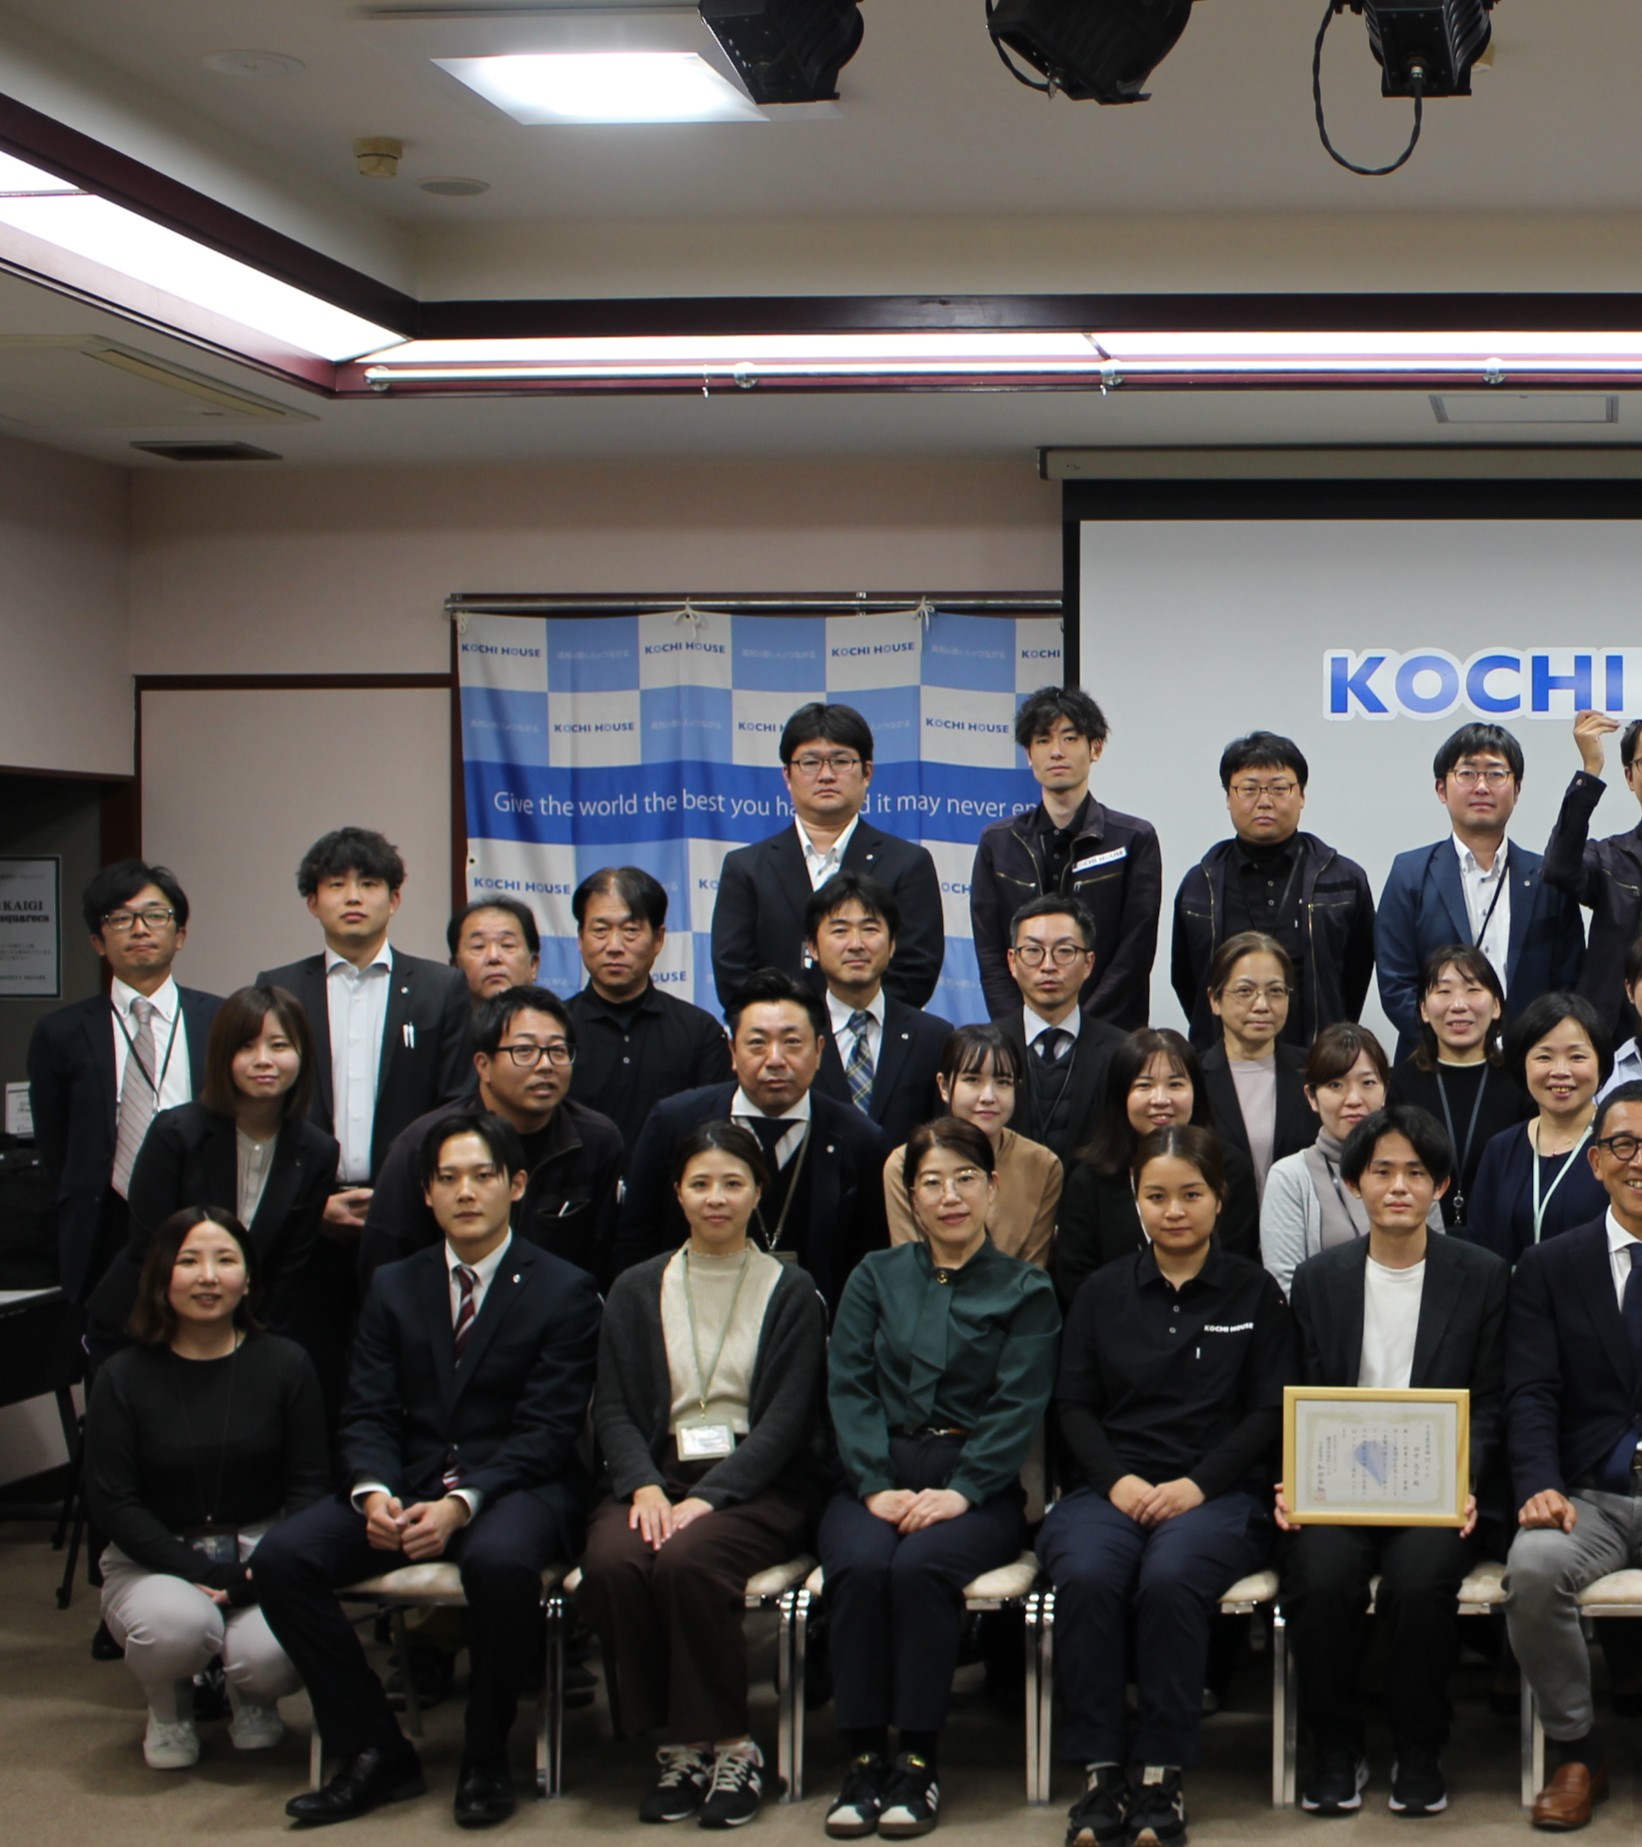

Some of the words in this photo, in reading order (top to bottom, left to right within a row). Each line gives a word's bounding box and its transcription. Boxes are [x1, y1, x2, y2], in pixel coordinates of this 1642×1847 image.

[461, 643, 498, 655] KOCHI
[501, 647, 541, 658] HOUSE
[645, 642, 683, 655] KOCHI
[686, 641, 726, 655] HOUSE
[832, 646, 870, 658] KOCHI
[873, 641, 915, 653] HOUSE
[1021, 649, 1061, 659] KOCHI
[1330, 654, 1623, 714] KOCHI
[554, 723, 591, 733] KOCHI
[595, 722, 634, 733] HOUSE
[738, 721, 777, 732] KOCHI
[926, 717, 965, 731] KOCHI
[968, 721, 1009, 734] HOUSE
[494, 791, 534, 814] Give
[541, 795, 574, 816] the
[579, 793, 637, 816] world
[645, 792, 677, 813] the
[682, 789, 725, 813] best
[730, 798, 770, 819] you
[877, 793, 891, 813] it
[897, 793, 941, 817] may
[947, 797, 1010, 817] never
[474, 877, 521, 891] KOCHI
[525, 881, 571, 895] HOUSE
[652, 971, 687, 984] OUSE
